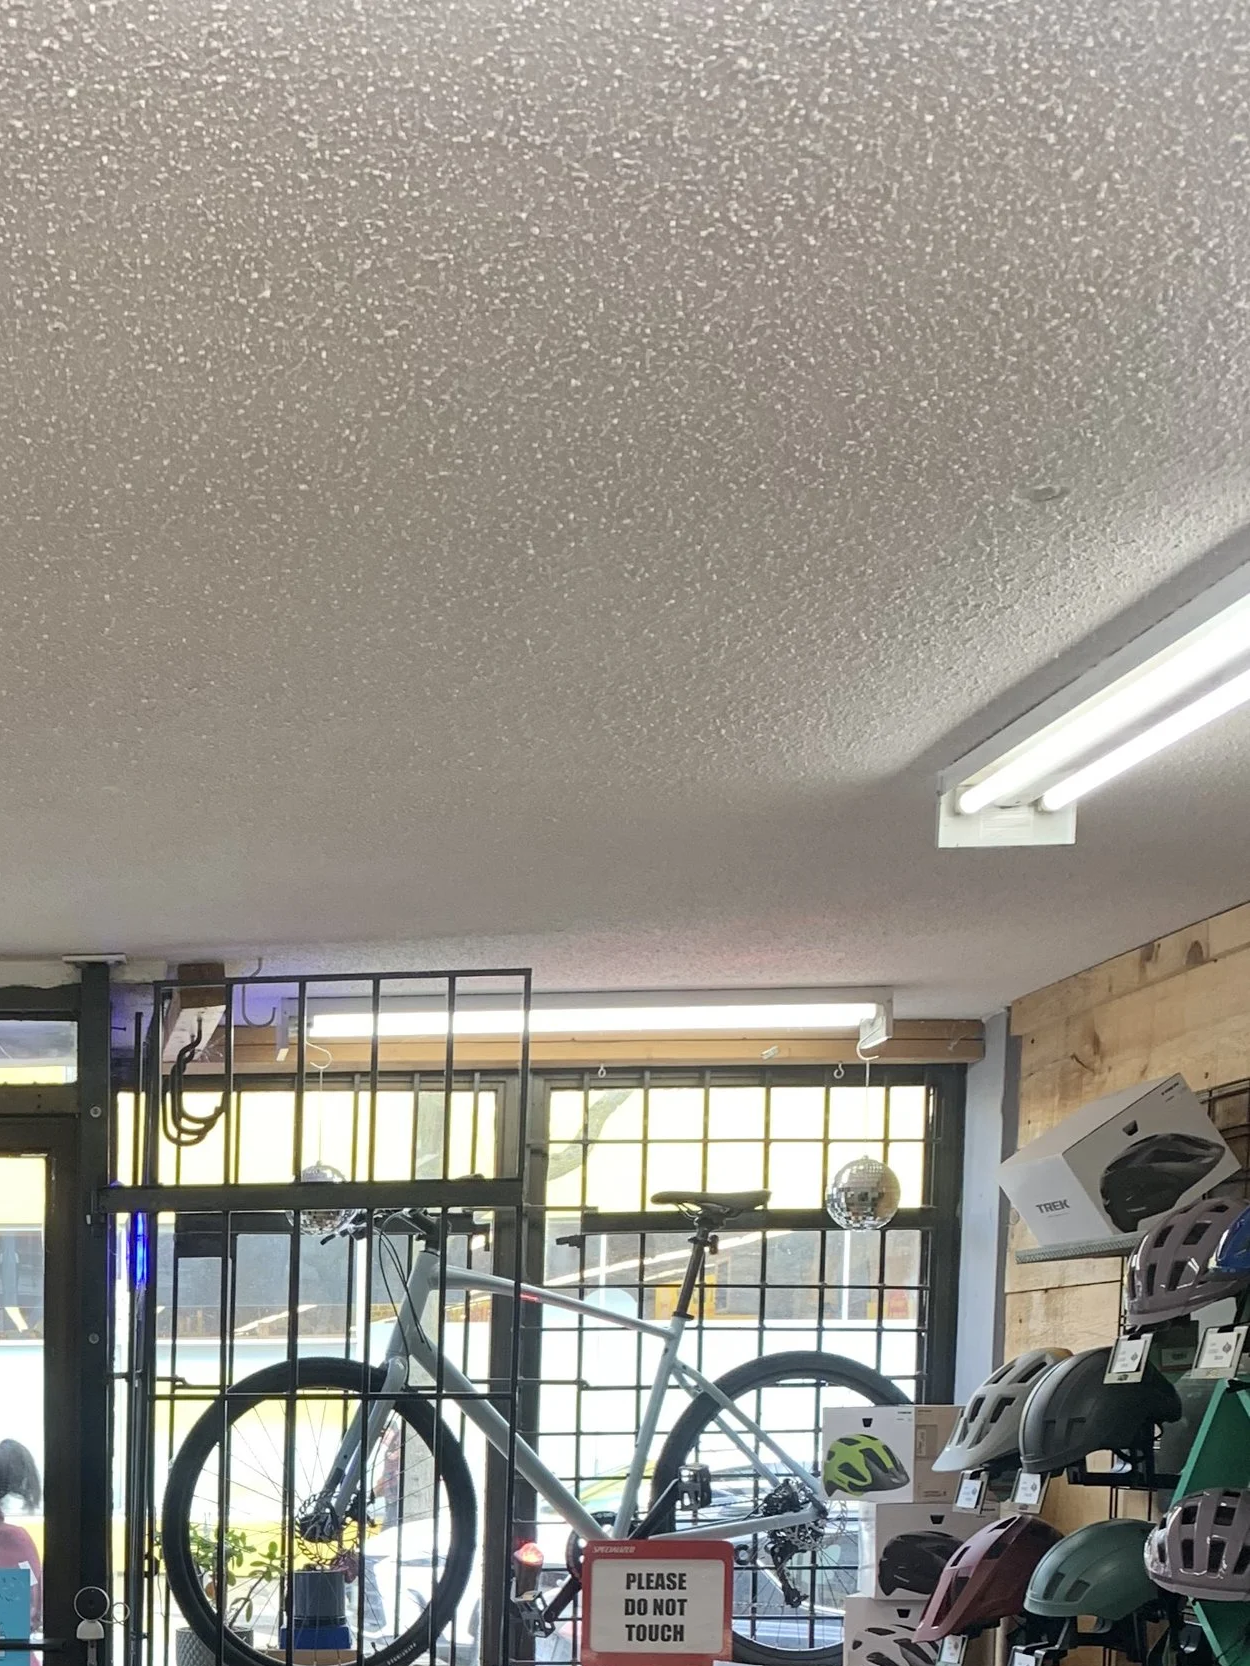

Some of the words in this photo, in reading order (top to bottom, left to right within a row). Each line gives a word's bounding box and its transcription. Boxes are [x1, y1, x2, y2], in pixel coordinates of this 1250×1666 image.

[1035, 1199, 1071, 1213] TREK
[625, 1572, 687, 1590] PLEASE
[624, 1598, 648, 1616] DO
[652, 1598, 688, 1616] NOT
[625, 1624, 685, 1642] TOUCH
